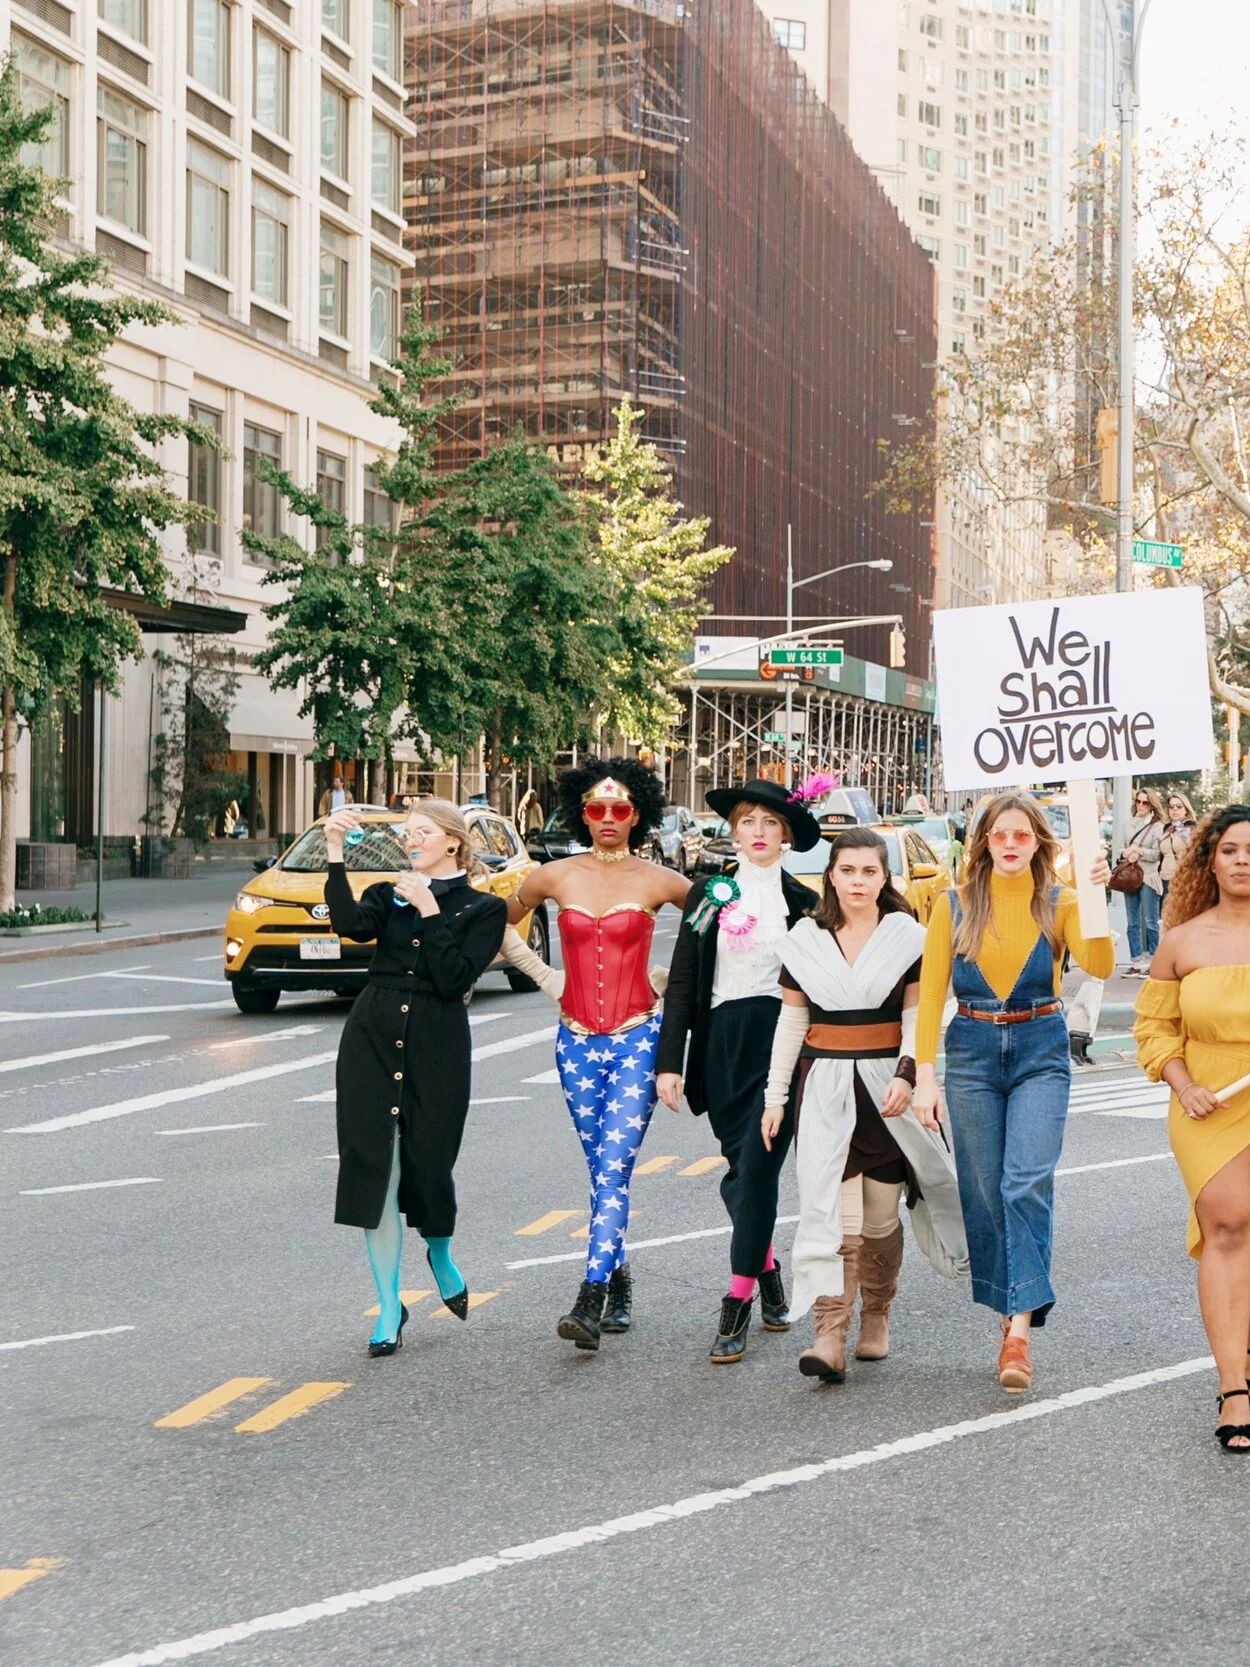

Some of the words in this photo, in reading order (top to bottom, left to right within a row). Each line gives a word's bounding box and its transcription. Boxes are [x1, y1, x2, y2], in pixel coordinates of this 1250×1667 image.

[1132, 541, 1173, 566] COLUMBUS
[786, 651, 796, 663] W
[799, 651, 813, 663] 64
[816, 651, 827, 663] St
[1008, 607, 1091, 669] We
[998, 641, 1111, 717] Shall
